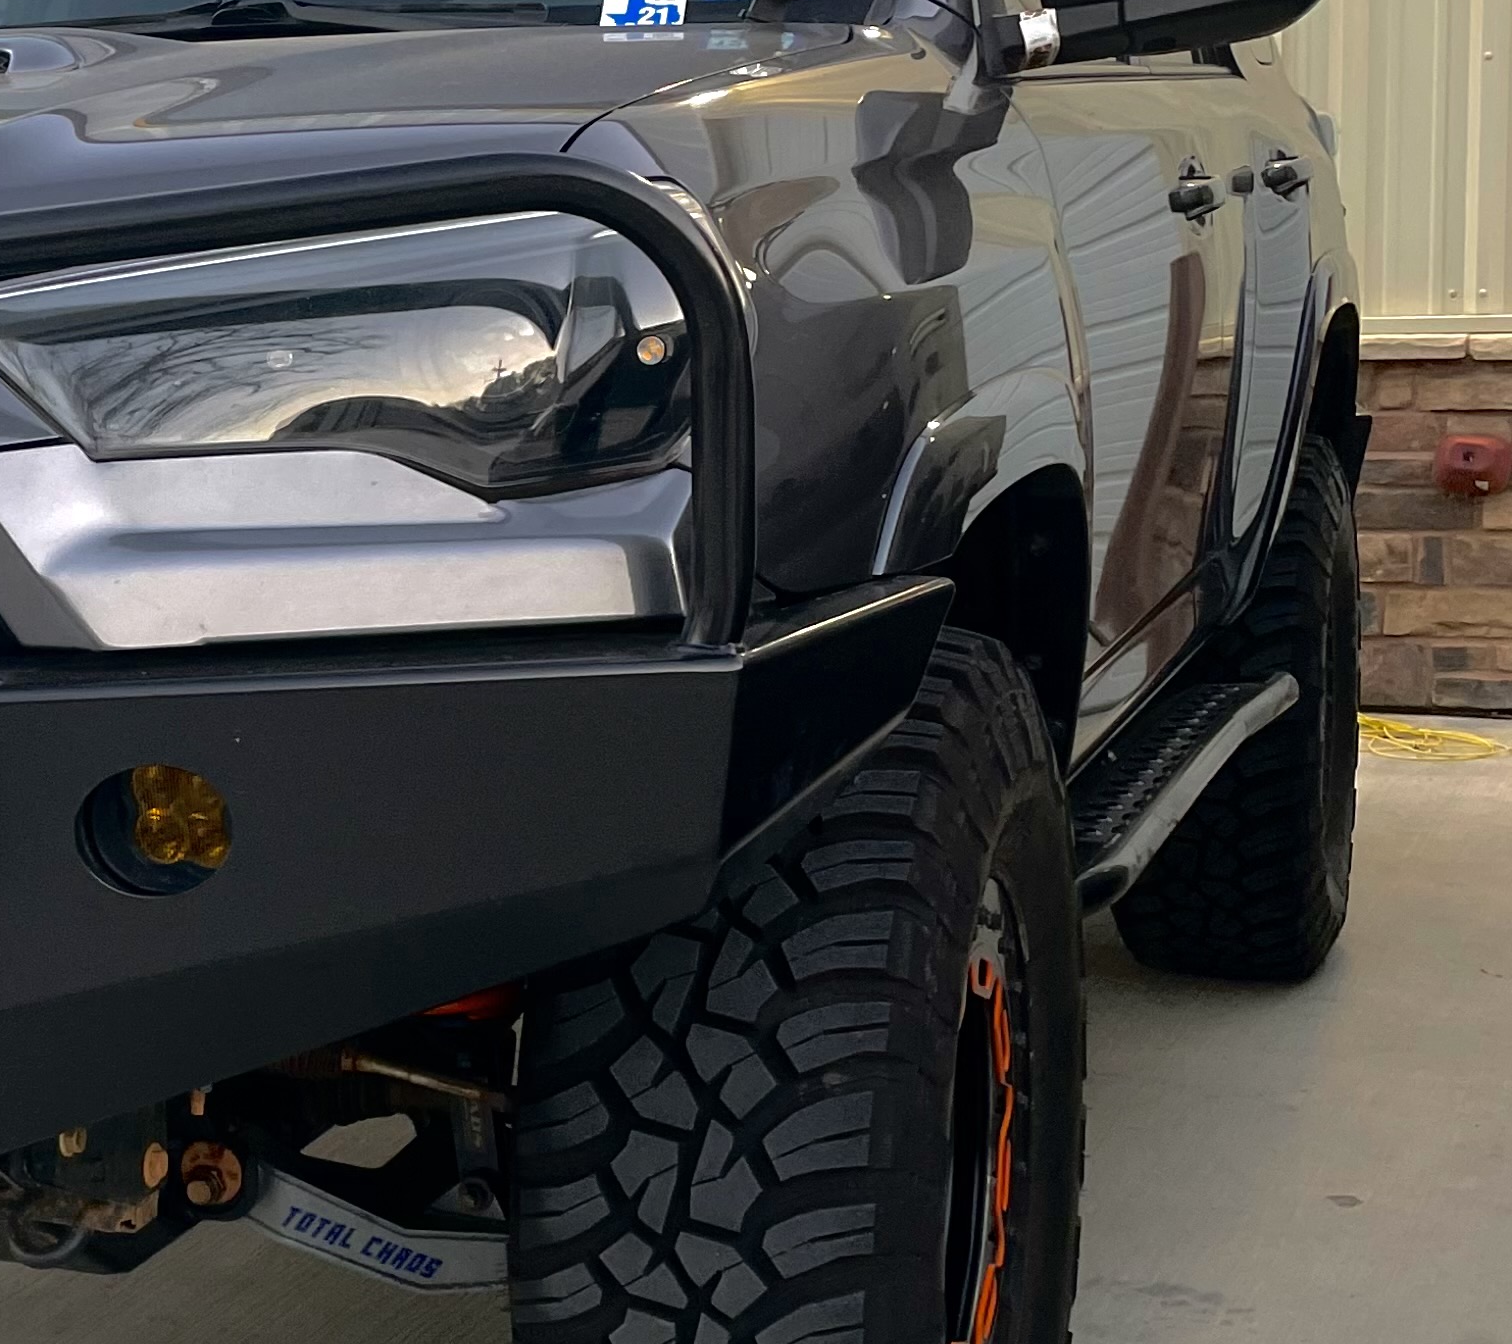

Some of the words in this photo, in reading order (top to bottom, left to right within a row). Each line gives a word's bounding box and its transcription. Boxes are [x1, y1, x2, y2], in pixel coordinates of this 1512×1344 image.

[637, 6, 669, 25] 21
[281, 1205, 357, 1249] TOTAL
[359, 1235, 444, 1279] CHAOS
